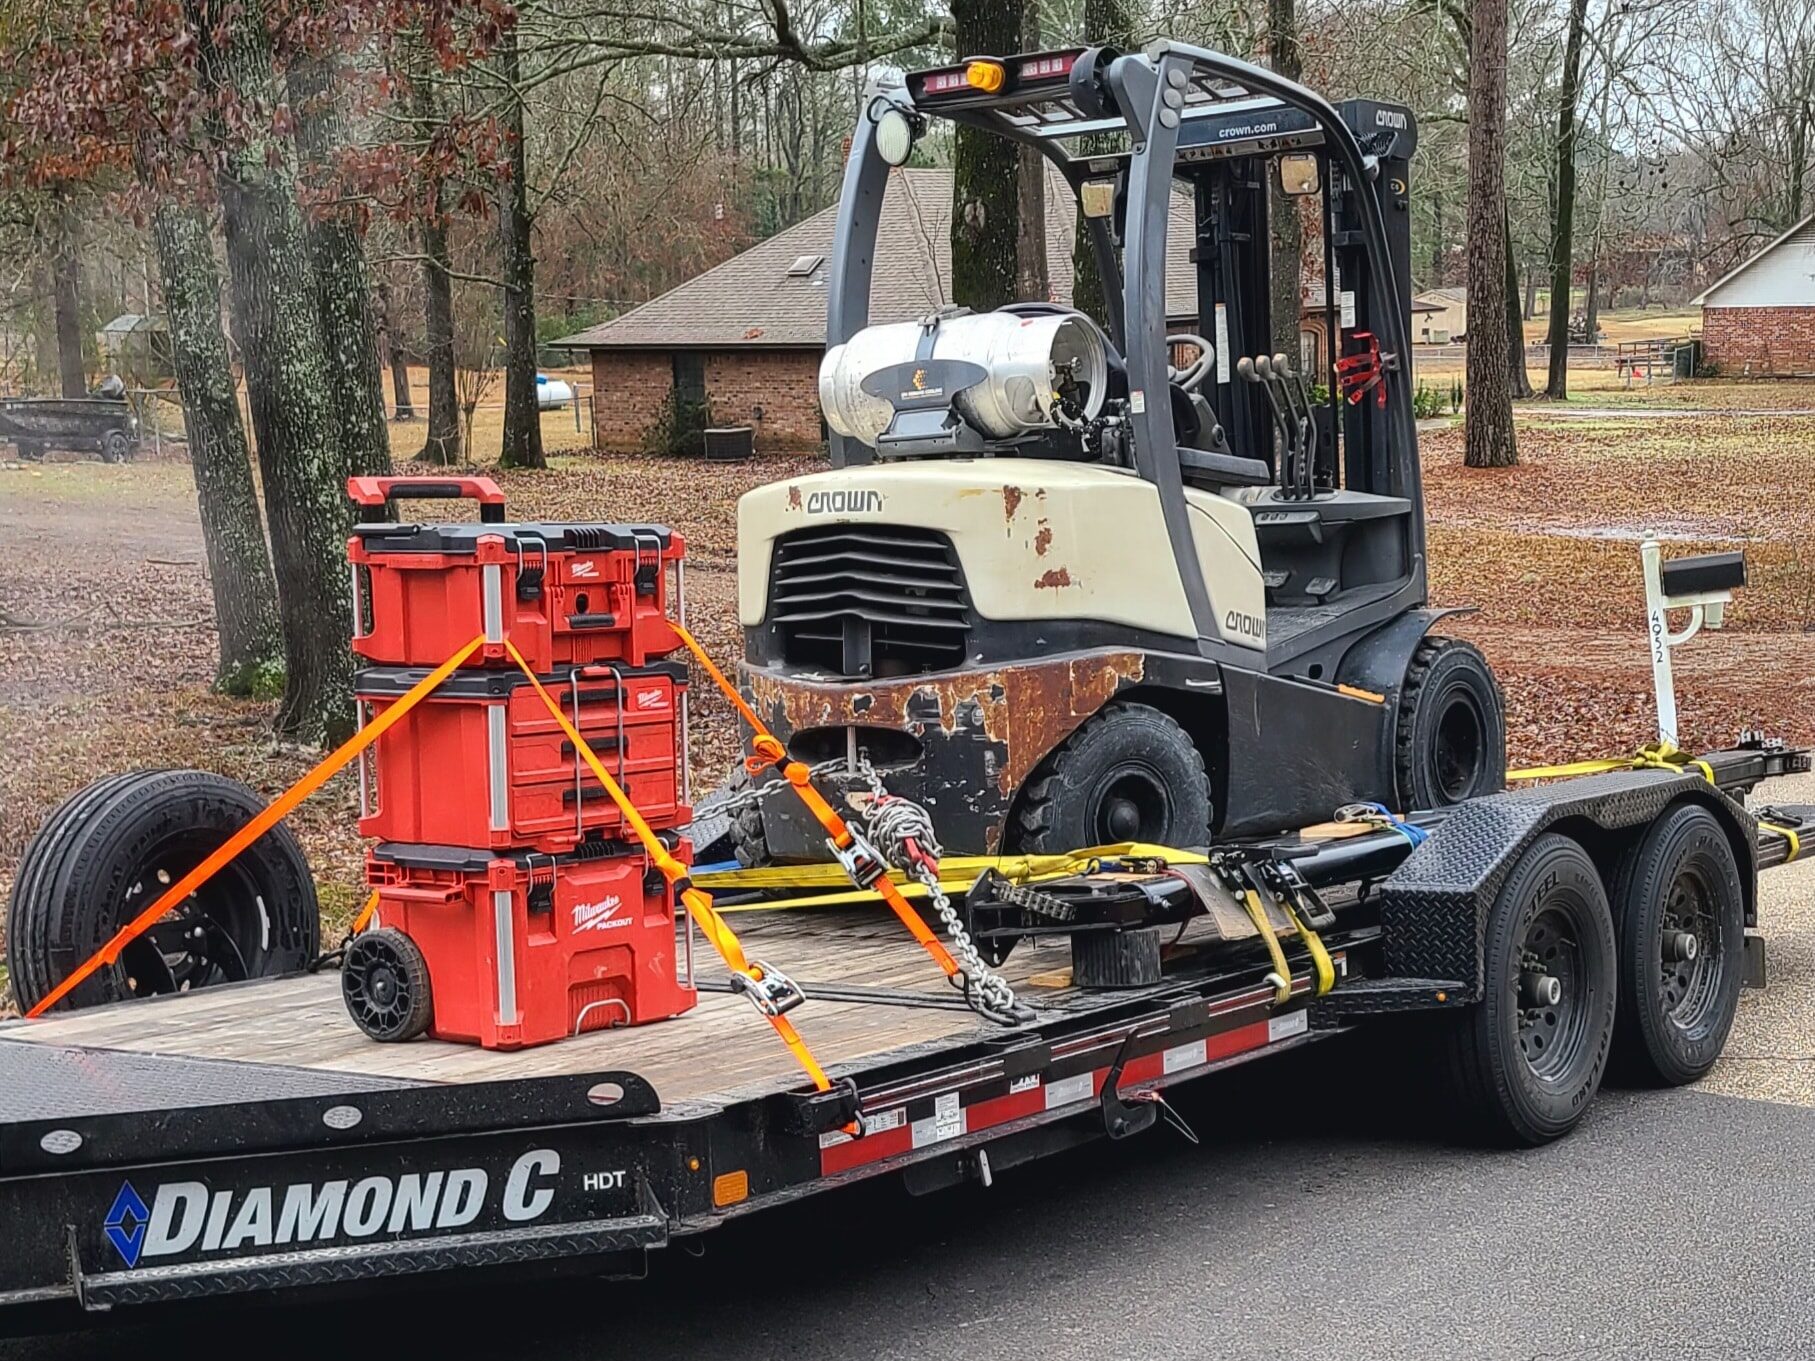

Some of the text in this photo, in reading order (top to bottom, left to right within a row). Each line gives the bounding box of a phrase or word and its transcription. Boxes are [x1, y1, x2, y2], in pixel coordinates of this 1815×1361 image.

[1218, 122, 1278, 138] crown.com
[1375, 109, 1408, 130] CROWN
[807, 490, 883, 514] CROWN
[1651, 610, 1664, 664] 4952
[1523, 870, 1560, 929] STEEL
[583, 1170, 627, 1192] HDT
[141, 1149, 561, 1257] DIAMOND C
